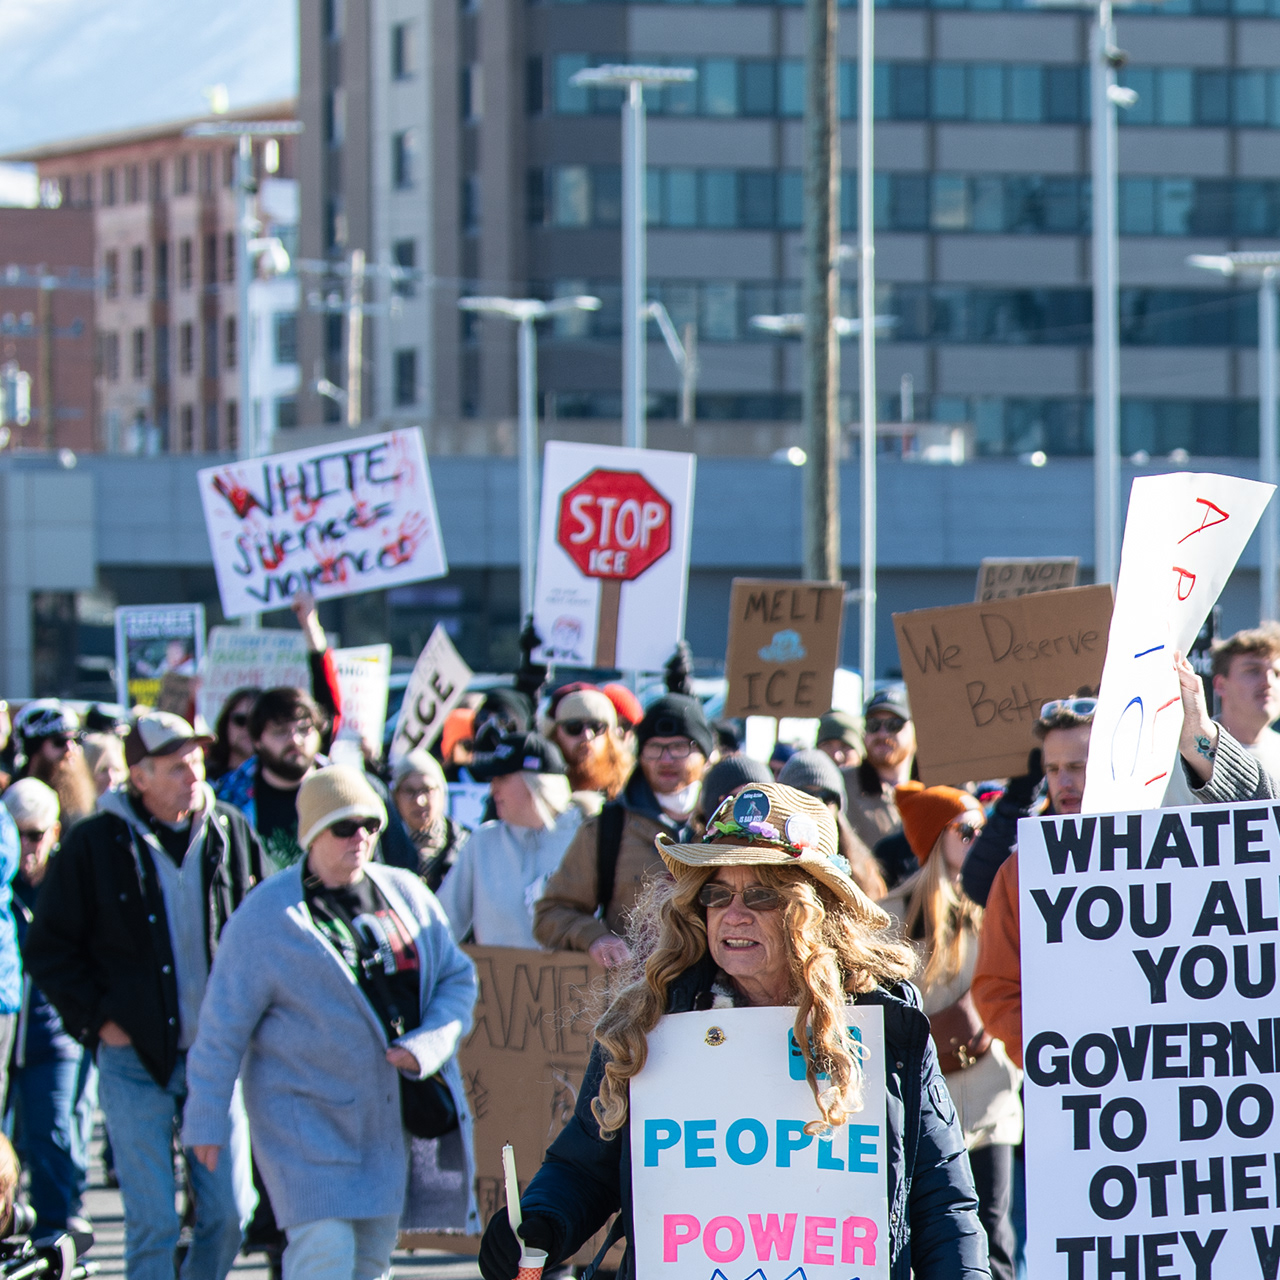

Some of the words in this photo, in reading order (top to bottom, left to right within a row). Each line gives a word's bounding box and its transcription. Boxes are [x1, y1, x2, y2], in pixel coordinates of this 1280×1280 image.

[213, 441, 402, 519] WHITE
[569, 494, 667, 549] STOP
[588, 549, 630, 574] ICE
[743, 588, 834, 623] MELT
[901, 624, 962, 674] We
[980, 613, 1099, 664] Deserve
[403, 669, 455, 749] ICE
[741, 669, 817, 712] ICE
[1029, 882, 1172, 944] YOU
[644, 1117, 880, 1174] PEOPLE
[1061, 1094, 1147, 1153] TO
[1178, 1082, 1274, 1143] DO
[662, 1212, 879, 1267] POWER
